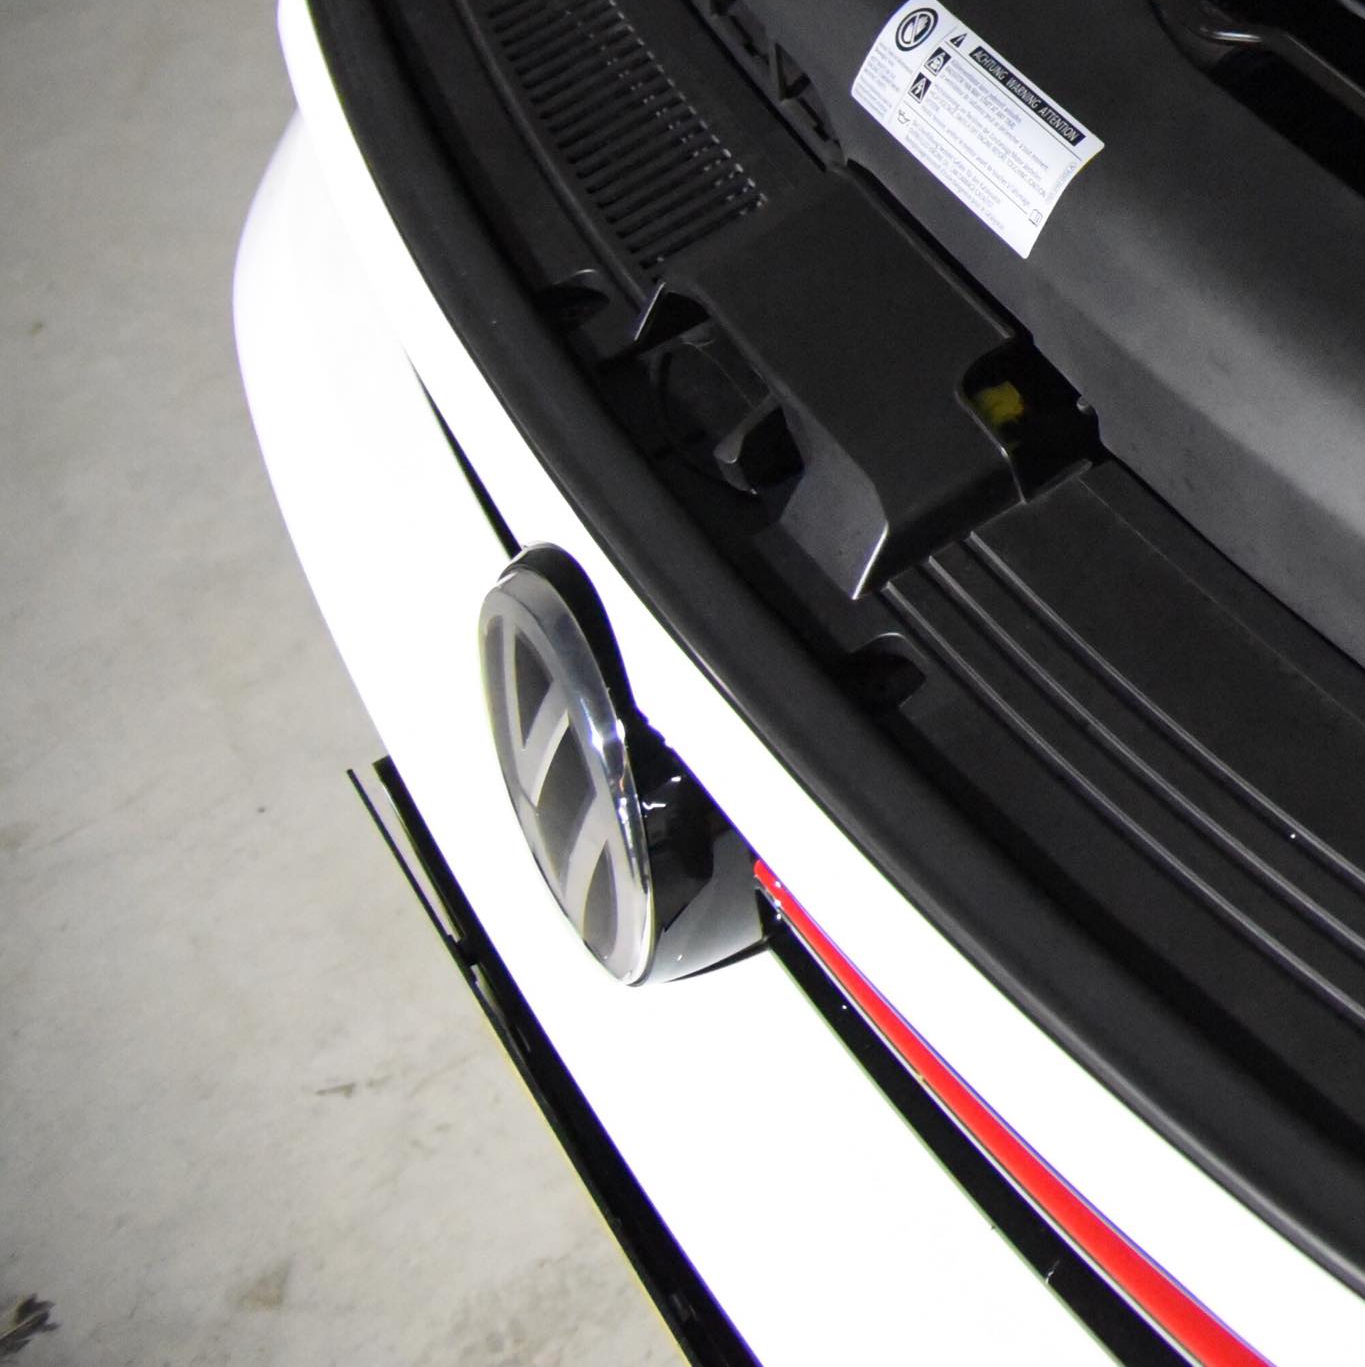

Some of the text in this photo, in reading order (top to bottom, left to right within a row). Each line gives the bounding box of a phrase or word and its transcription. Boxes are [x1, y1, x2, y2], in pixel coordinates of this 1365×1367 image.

[972, 49, 1081, 142] ACHTUNG WARNING ATTENTION
